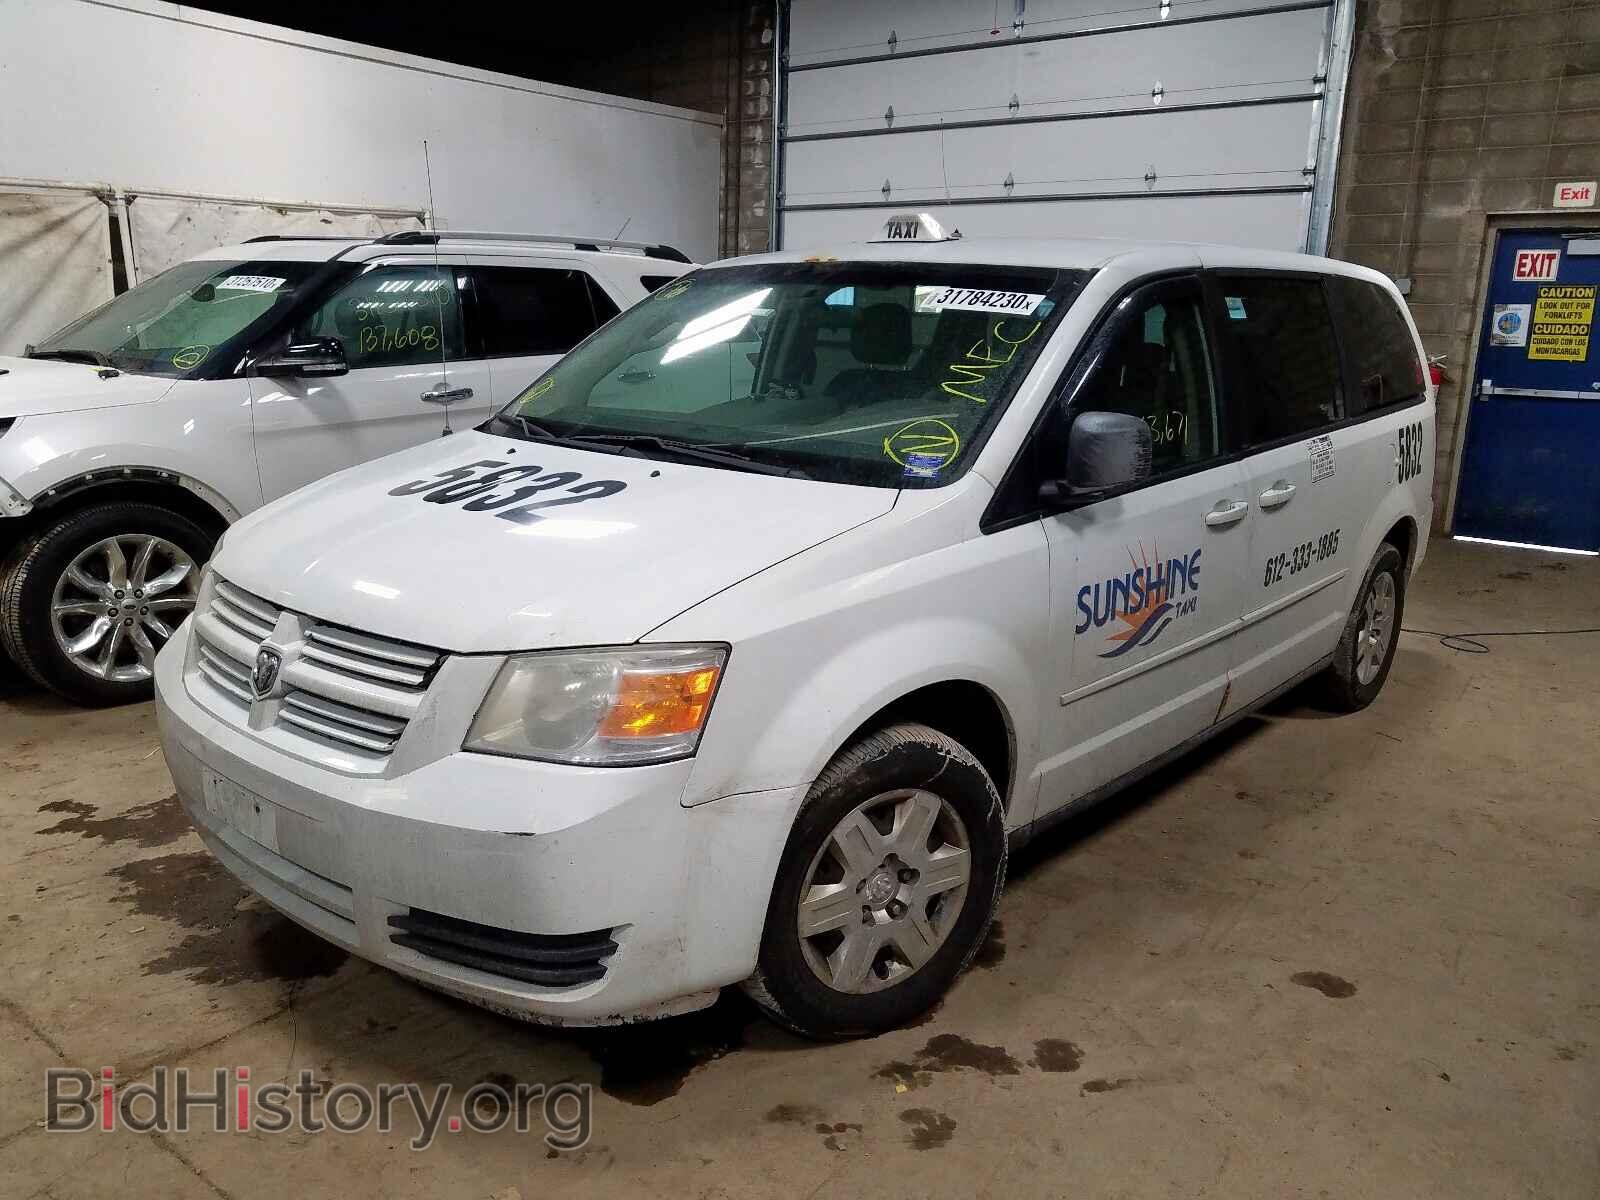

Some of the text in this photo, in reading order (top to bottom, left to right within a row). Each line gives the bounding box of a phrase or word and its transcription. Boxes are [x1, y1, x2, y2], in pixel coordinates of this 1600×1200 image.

[1560, 187, 1591, 200] Exit
[887, 219, 919, 239] TAXI
[1516, 253, 1557, 278] EXIT
[1540, 287, 1595, 298] CAUTION
[1540, 302, 1591, 310] LOOK OUT FOR
[1544, 311, 1583, 320] FORKLIFTS
[1534, 324, 1588, 335] CUIDADO
[1398, 421, 1423, 484] 5832
[387, 460, 627, 526] 5832
[1263, 529, 1341, 587] 612-333-1885
[1075, 548, 1202, 634] SUNSHINE
[1175, 596, 1199, 619] TAXI
